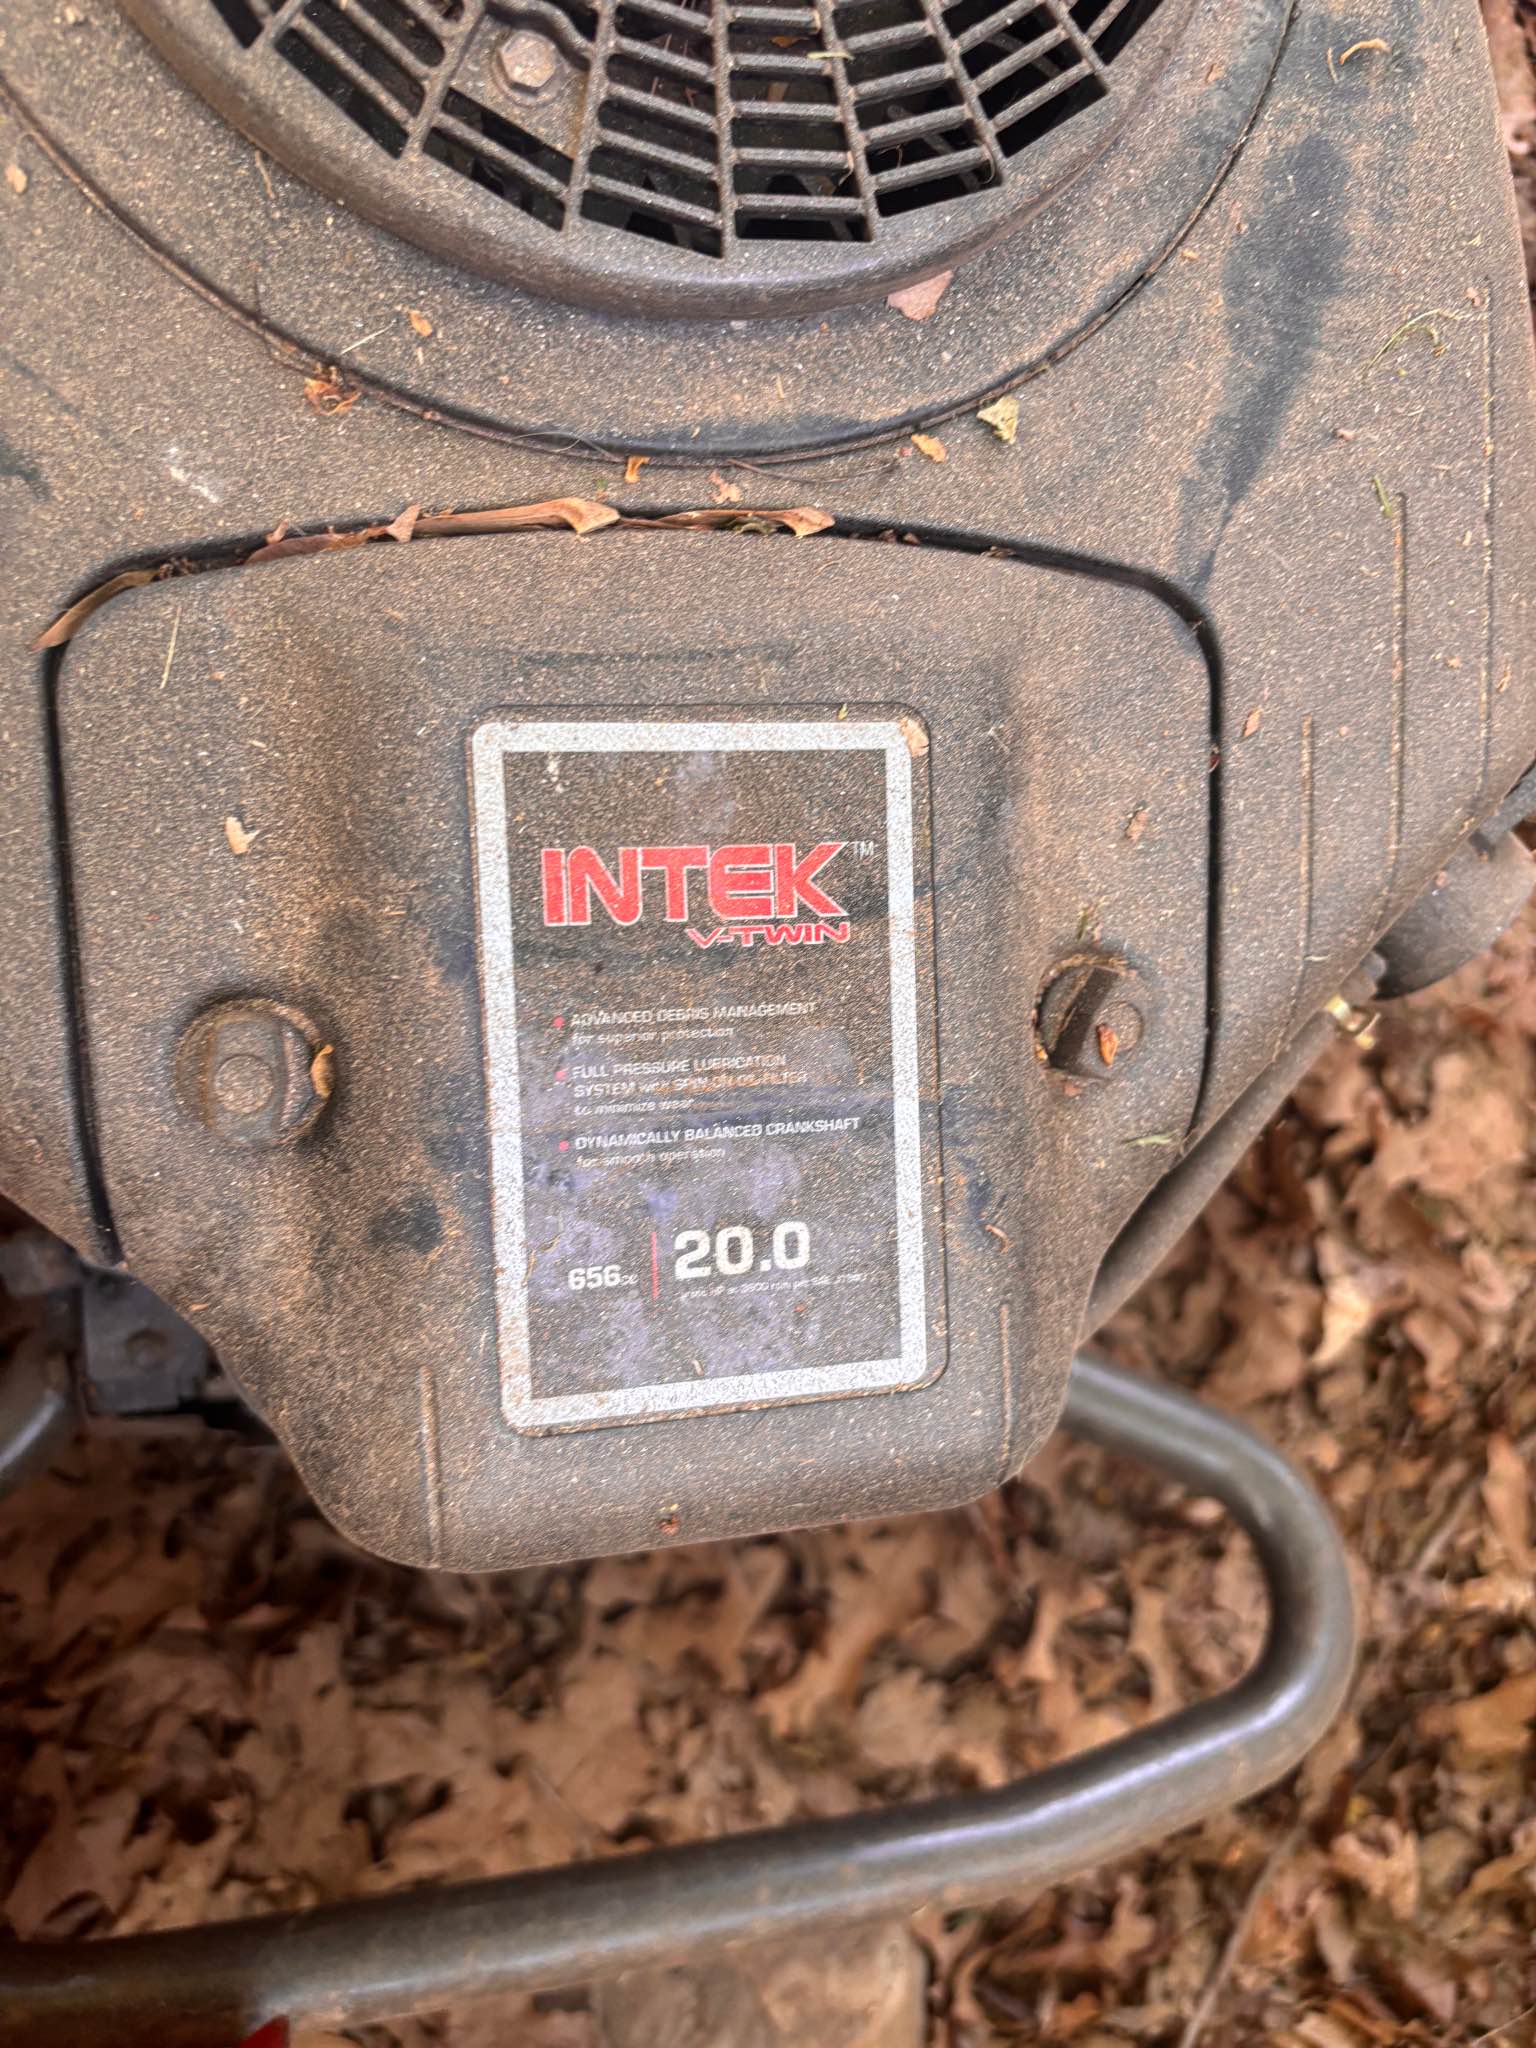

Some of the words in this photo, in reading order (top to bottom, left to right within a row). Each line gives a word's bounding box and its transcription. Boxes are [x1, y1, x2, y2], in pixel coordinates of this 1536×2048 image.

[540, 841, 849, 927] INTEK
[686, 921, 851, 949] V-TWIN
[570, 1010, 652, 1027] ADVANCED
[655, 1007, 710, 1023] DEBRIS
[713, 1001, 817, 1020] MANAGEMENT
[571, 1032, 596, 1046] for
[571, 1064, 610, 1080] FULL
[613, 1059, 690, 1077] PRESSURE
[693, 1054, 787, 1073] LUBRICATION
[573, 1080, 638, 1098] SYSTEM
[575, 1129, 682, 1151] DYNAMICALLY
[685, 1123, 763, 1142] BALANCED
[765, 1116, 861, 1136] CRANKSHAFT
[673, 1220, 811, 1281] 20.0
